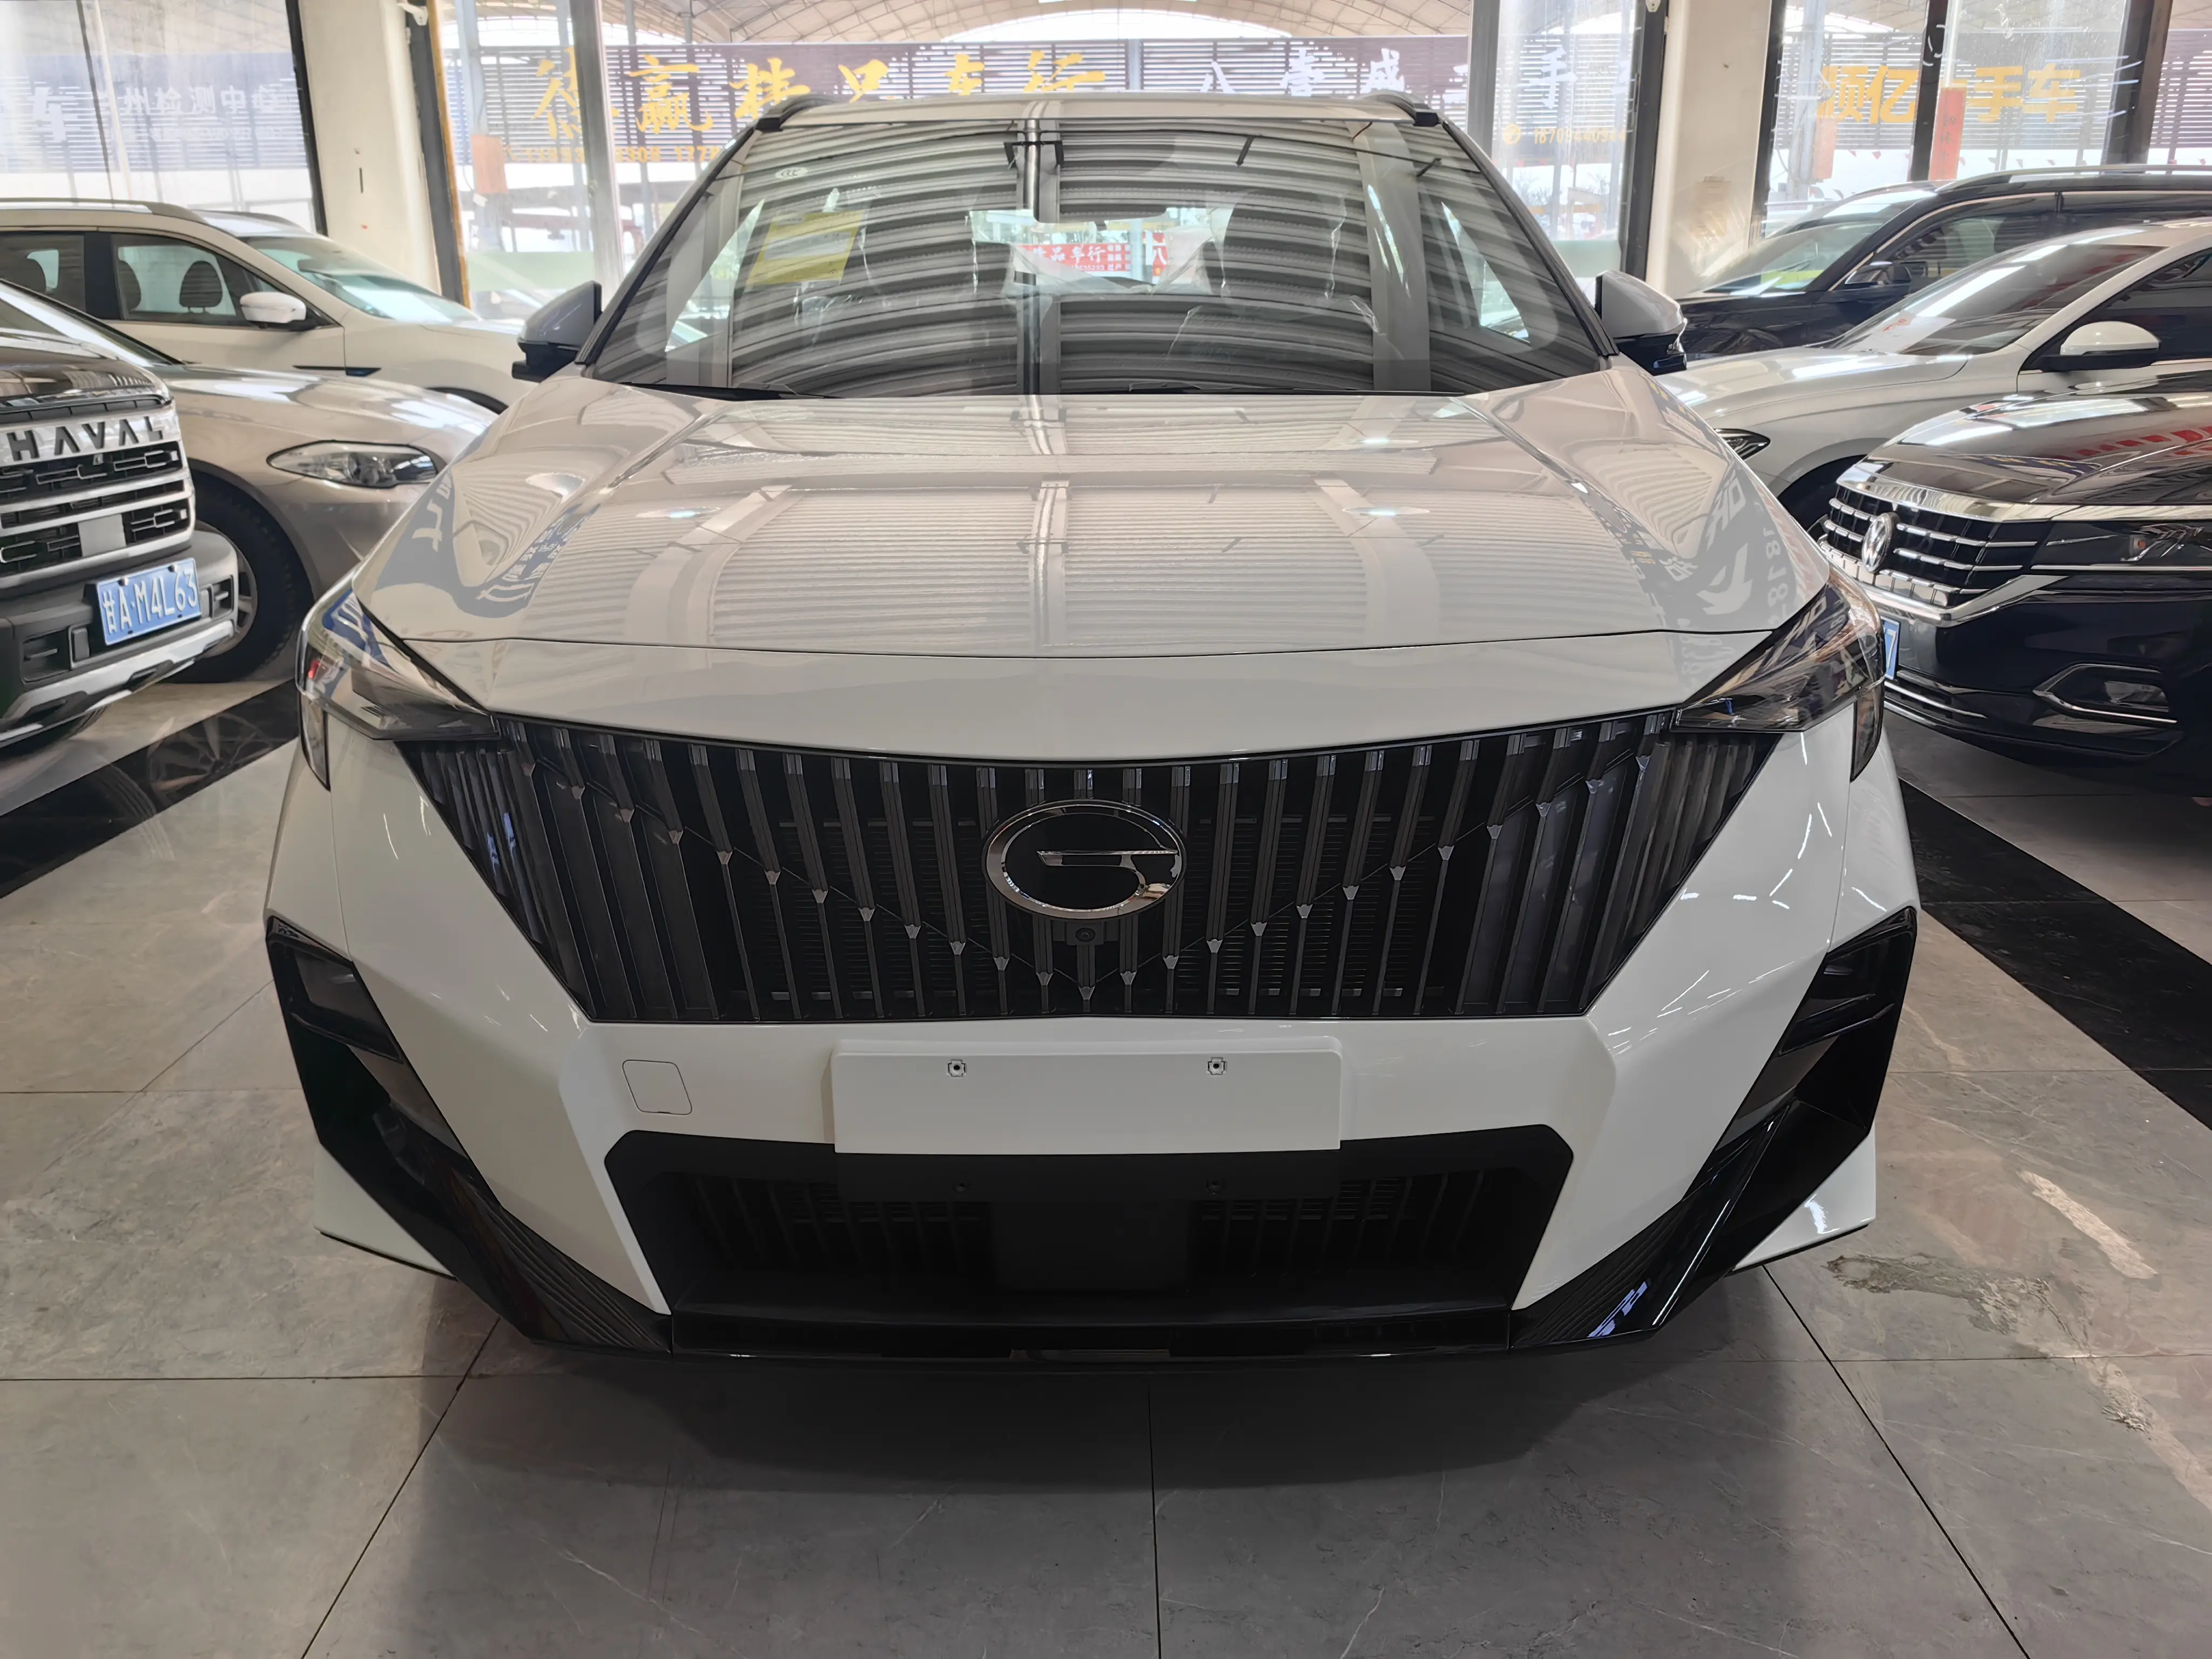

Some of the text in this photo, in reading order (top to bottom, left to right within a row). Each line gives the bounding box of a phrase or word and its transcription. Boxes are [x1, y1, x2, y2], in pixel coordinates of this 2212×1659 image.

[1818, 63, 2081, 124] 亿手车
[7, 416, 164, 461] HAVAL
